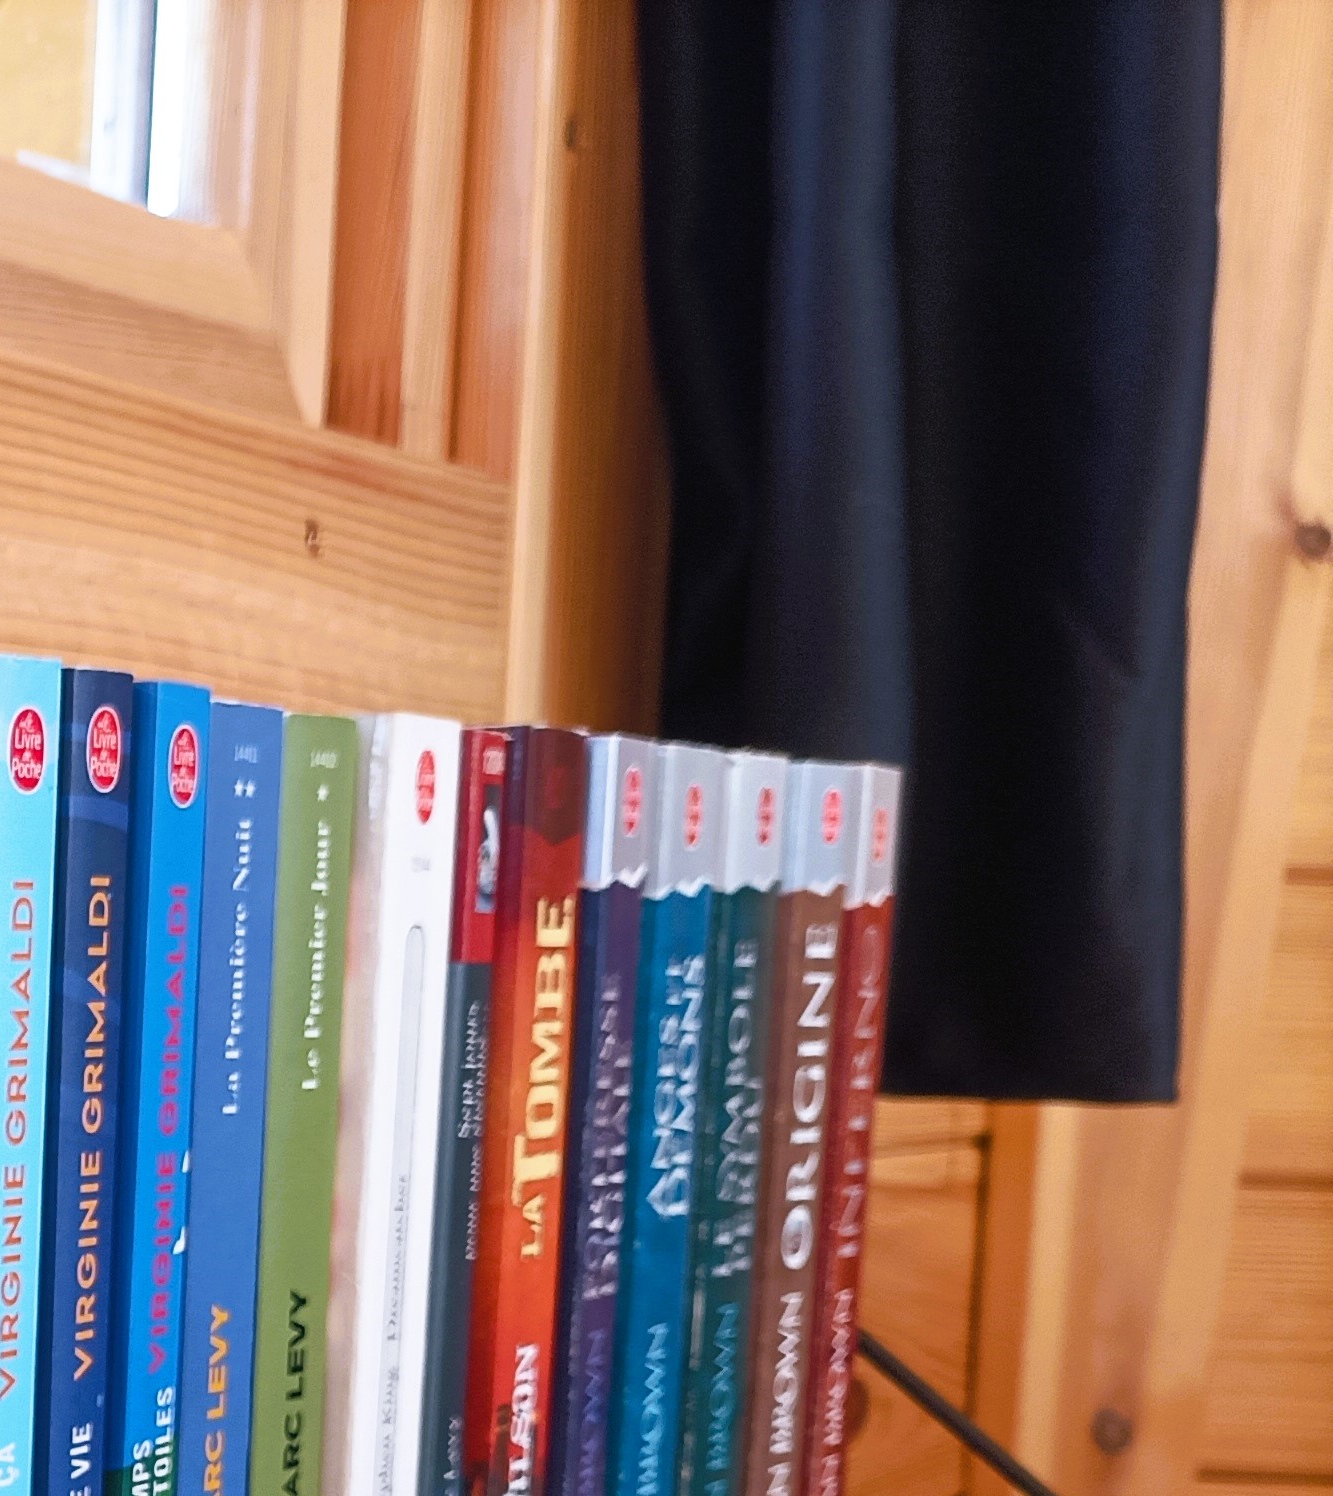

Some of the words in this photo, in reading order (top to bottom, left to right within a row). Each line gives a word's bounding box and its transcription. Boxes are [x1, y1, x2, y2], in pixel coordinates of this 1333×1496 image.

[12, 758, 41, 778] Poche
[14, 729, 41, 750] Livre
[93, 728, 117, 749] Livre
[4, 879, 35, 1147] GRIMALDI
[80, 875, 113, 1135] GRIMALDI
[157, 886, 188, 1137] GRIMALDI
[511, 893, 576, 1207] TOMBE
[780, 924, 838, 1270] ORIGINE
[73, 1149, 103, 1380] VIRGINIE
[149, 1151, 176, 1373] VIRGINIE
[206, 1303, 231, 1420] LEVY
[285, 1289, 308, 1401] LEVY
[69, 1422, 92, 1470] VIE
